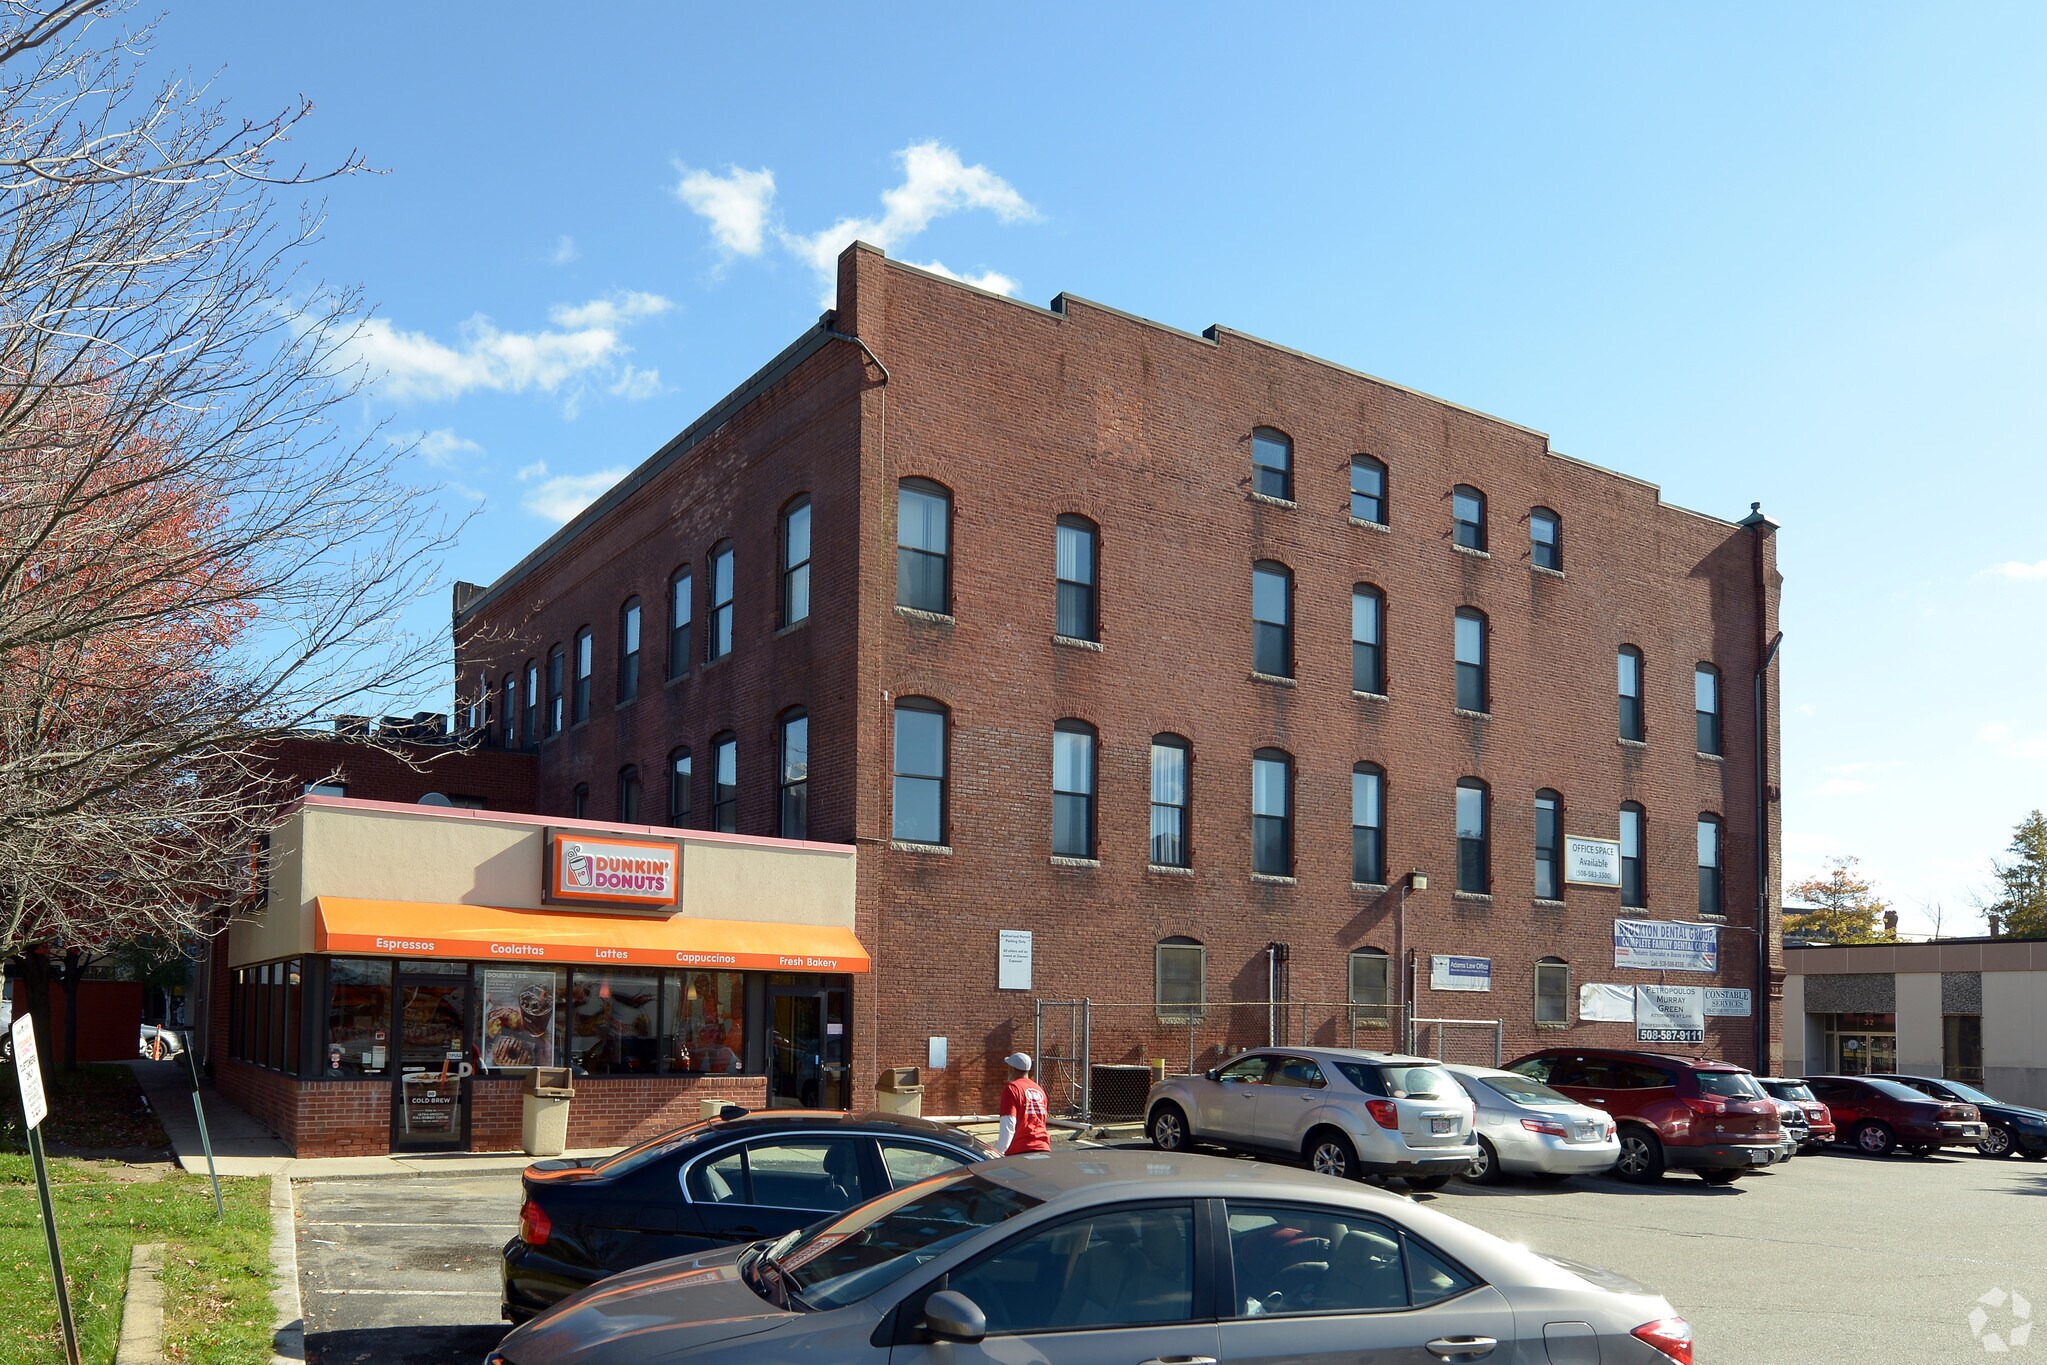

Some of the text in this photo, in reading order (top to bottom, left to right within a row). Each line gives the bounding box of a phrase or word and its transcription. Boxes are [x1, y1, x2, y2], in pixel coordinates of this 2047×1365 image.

[1572, 844, 1614, 856] OFFICE SPACE
[596, 856, 669, 875] DUNKIN'
[1579, 858, 1608, 868] Available
[595, 872, 665, 891] DONUTS
[1661, 926, 1687, 939] DENTAL
[1689, 927, 1712, 941] GROUP
[376, 938, 435, 950] Espressos
[490, 943, 544, 956] Coolattas
[1622, 937, 1709, 952] COMPLETE FAMILY DENTAL CARE
[595, 948, 628, 959] Lattes
[676, 952, 736, 964] Cappuccinos
[779, 956, 837, 969] Fresh Bakery
[1646, 986, 1695, 995] PETROPOULOS
[1705, 990, 1749, 1000] CONSTABLE
[1656, 995, 1686, 1004] MURRAY
[1711, 1000, 1744, 1009] SERVICES
[1640, 1030, 1702, 1040] 508-587-9111
